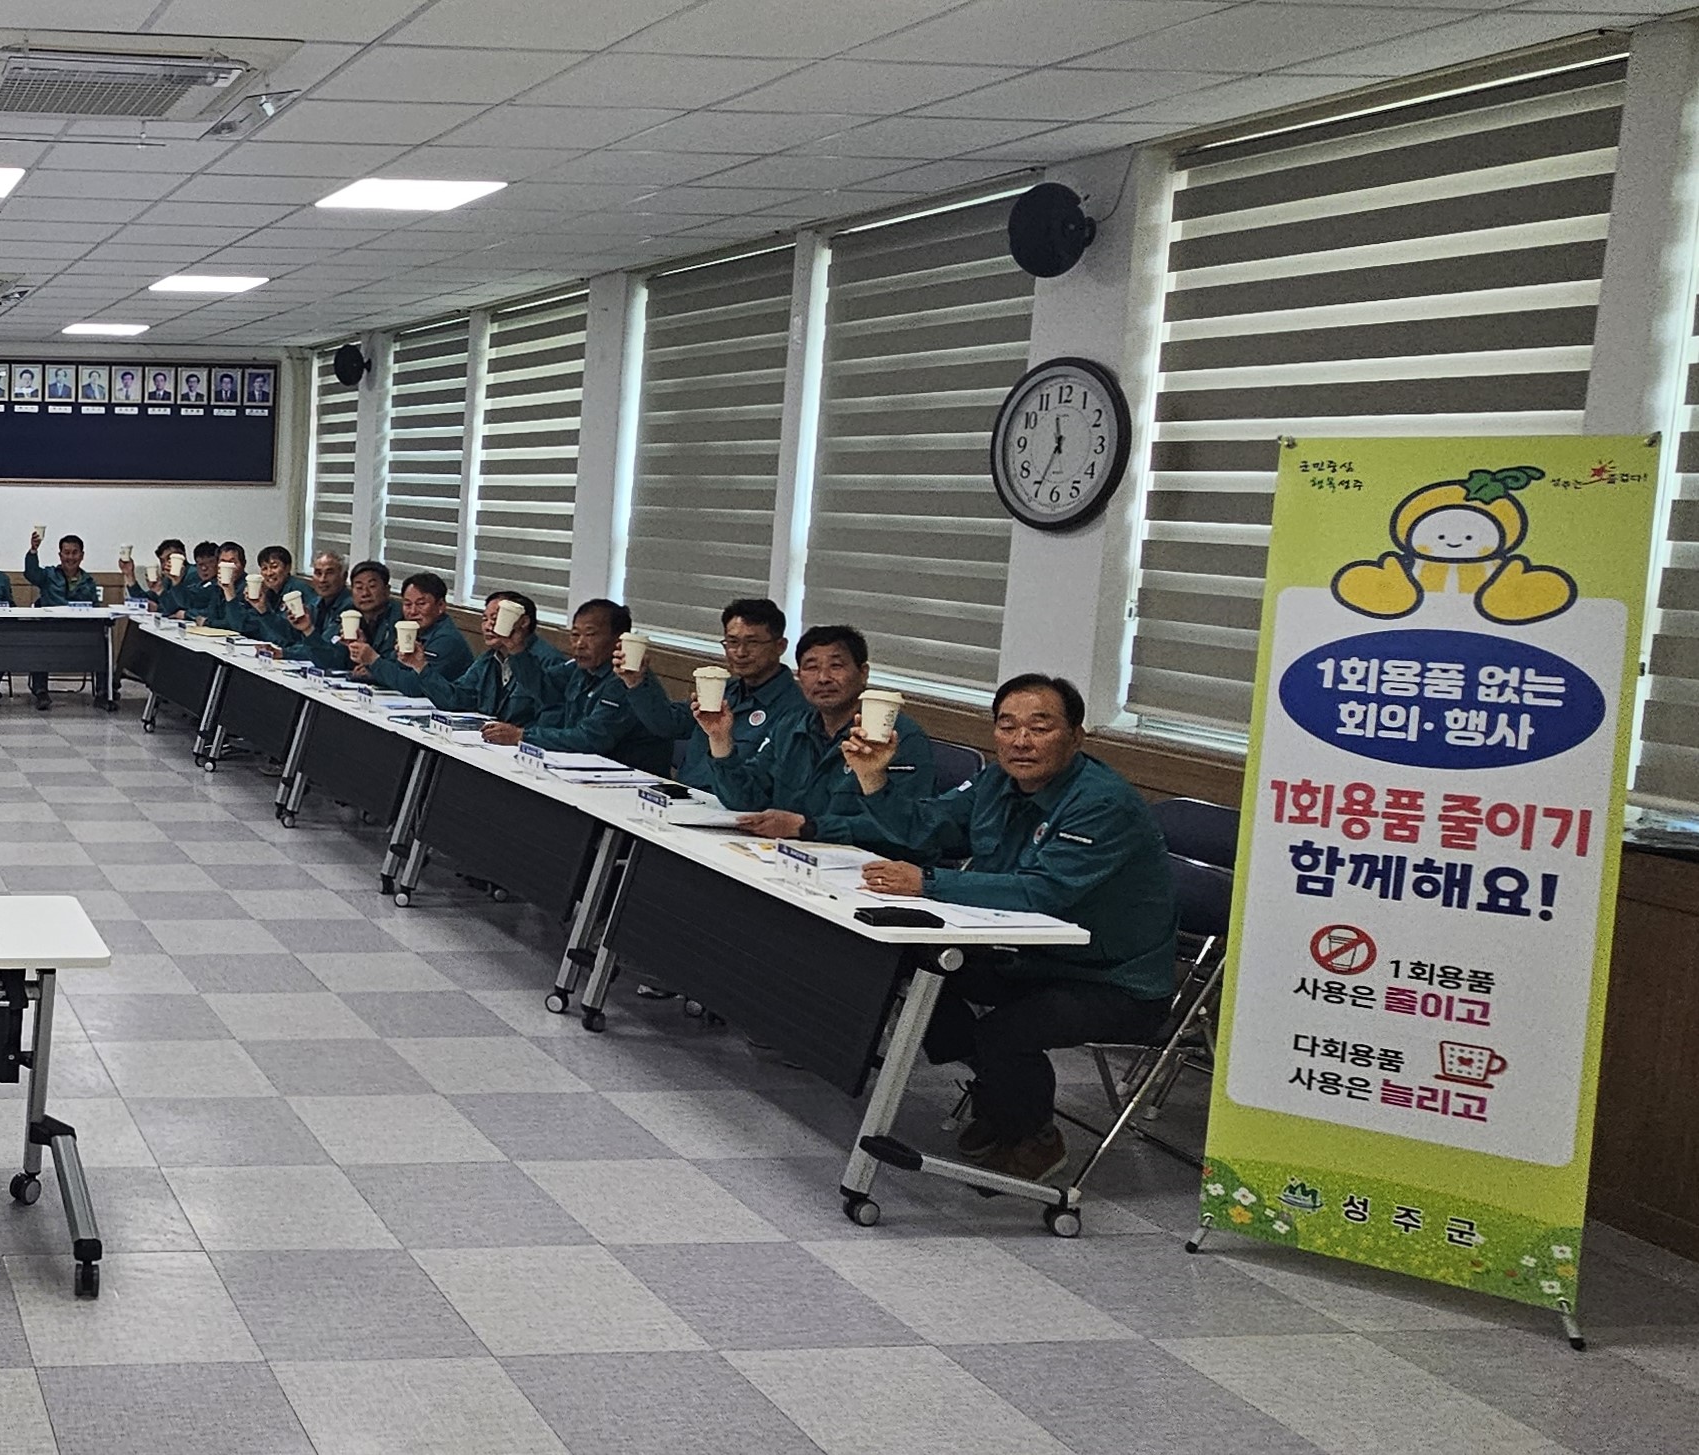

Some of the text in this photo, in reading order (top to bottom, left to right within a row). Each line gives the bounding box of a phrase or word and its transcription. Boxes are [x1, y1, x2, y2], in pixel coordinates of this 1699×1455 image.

[1038, 393, 1050, 411] 11
[1058, 385, 1073, 404] 12
[1082, 391, 1088, 410] 1
[1024, 411, 1038, 430] 10
[1092, 409, 1103, 428] 2
[1017, 436, 1028, 453] 9
[1093, 435, 1106, 454] 3
[1020, 460, 1031, 479] 8
[1084, 461, 1096, 479] 4
[1033, 480, 1043, 498] 7
[1049, 485, 1060, 503] 6
[1069, 480, 1081, 499] 5
[1316, 656, 1566, 707] 1회용품 없는
[1270, 778, 1593, 857] 1회용품 줄이기
[1288, 839, 1559, 921] 함께해요!
[1293, 977, 1491, 1026] 사용은 줄이고
[1293, 1033, 1405, 1073] 다회용품
[1288, 1067, 1487, 1122] 사용은 늘리고
